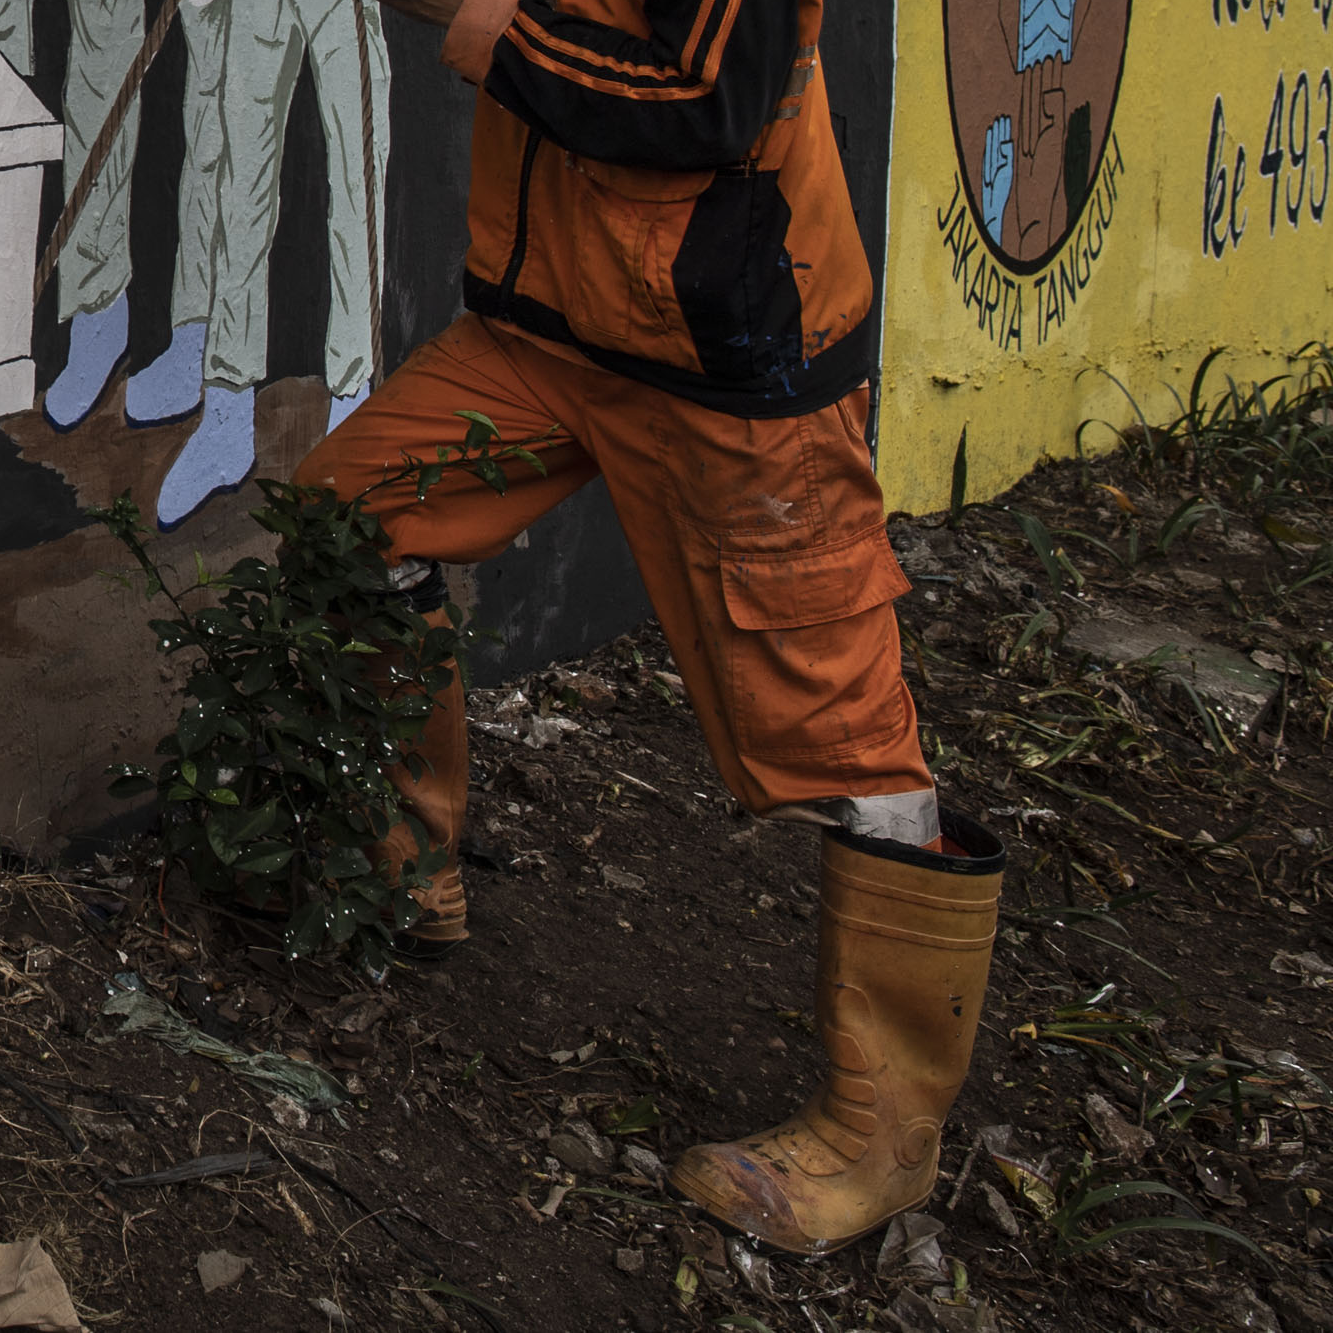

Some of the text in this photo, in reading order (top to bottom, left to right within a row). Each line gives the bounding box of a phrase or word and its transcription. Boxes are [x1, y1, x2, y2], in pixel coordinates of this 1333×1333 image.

[937, 130, 1125, 353] JAKARTA TANGGUH
[1202, 68, 1333, 261] ke 493
